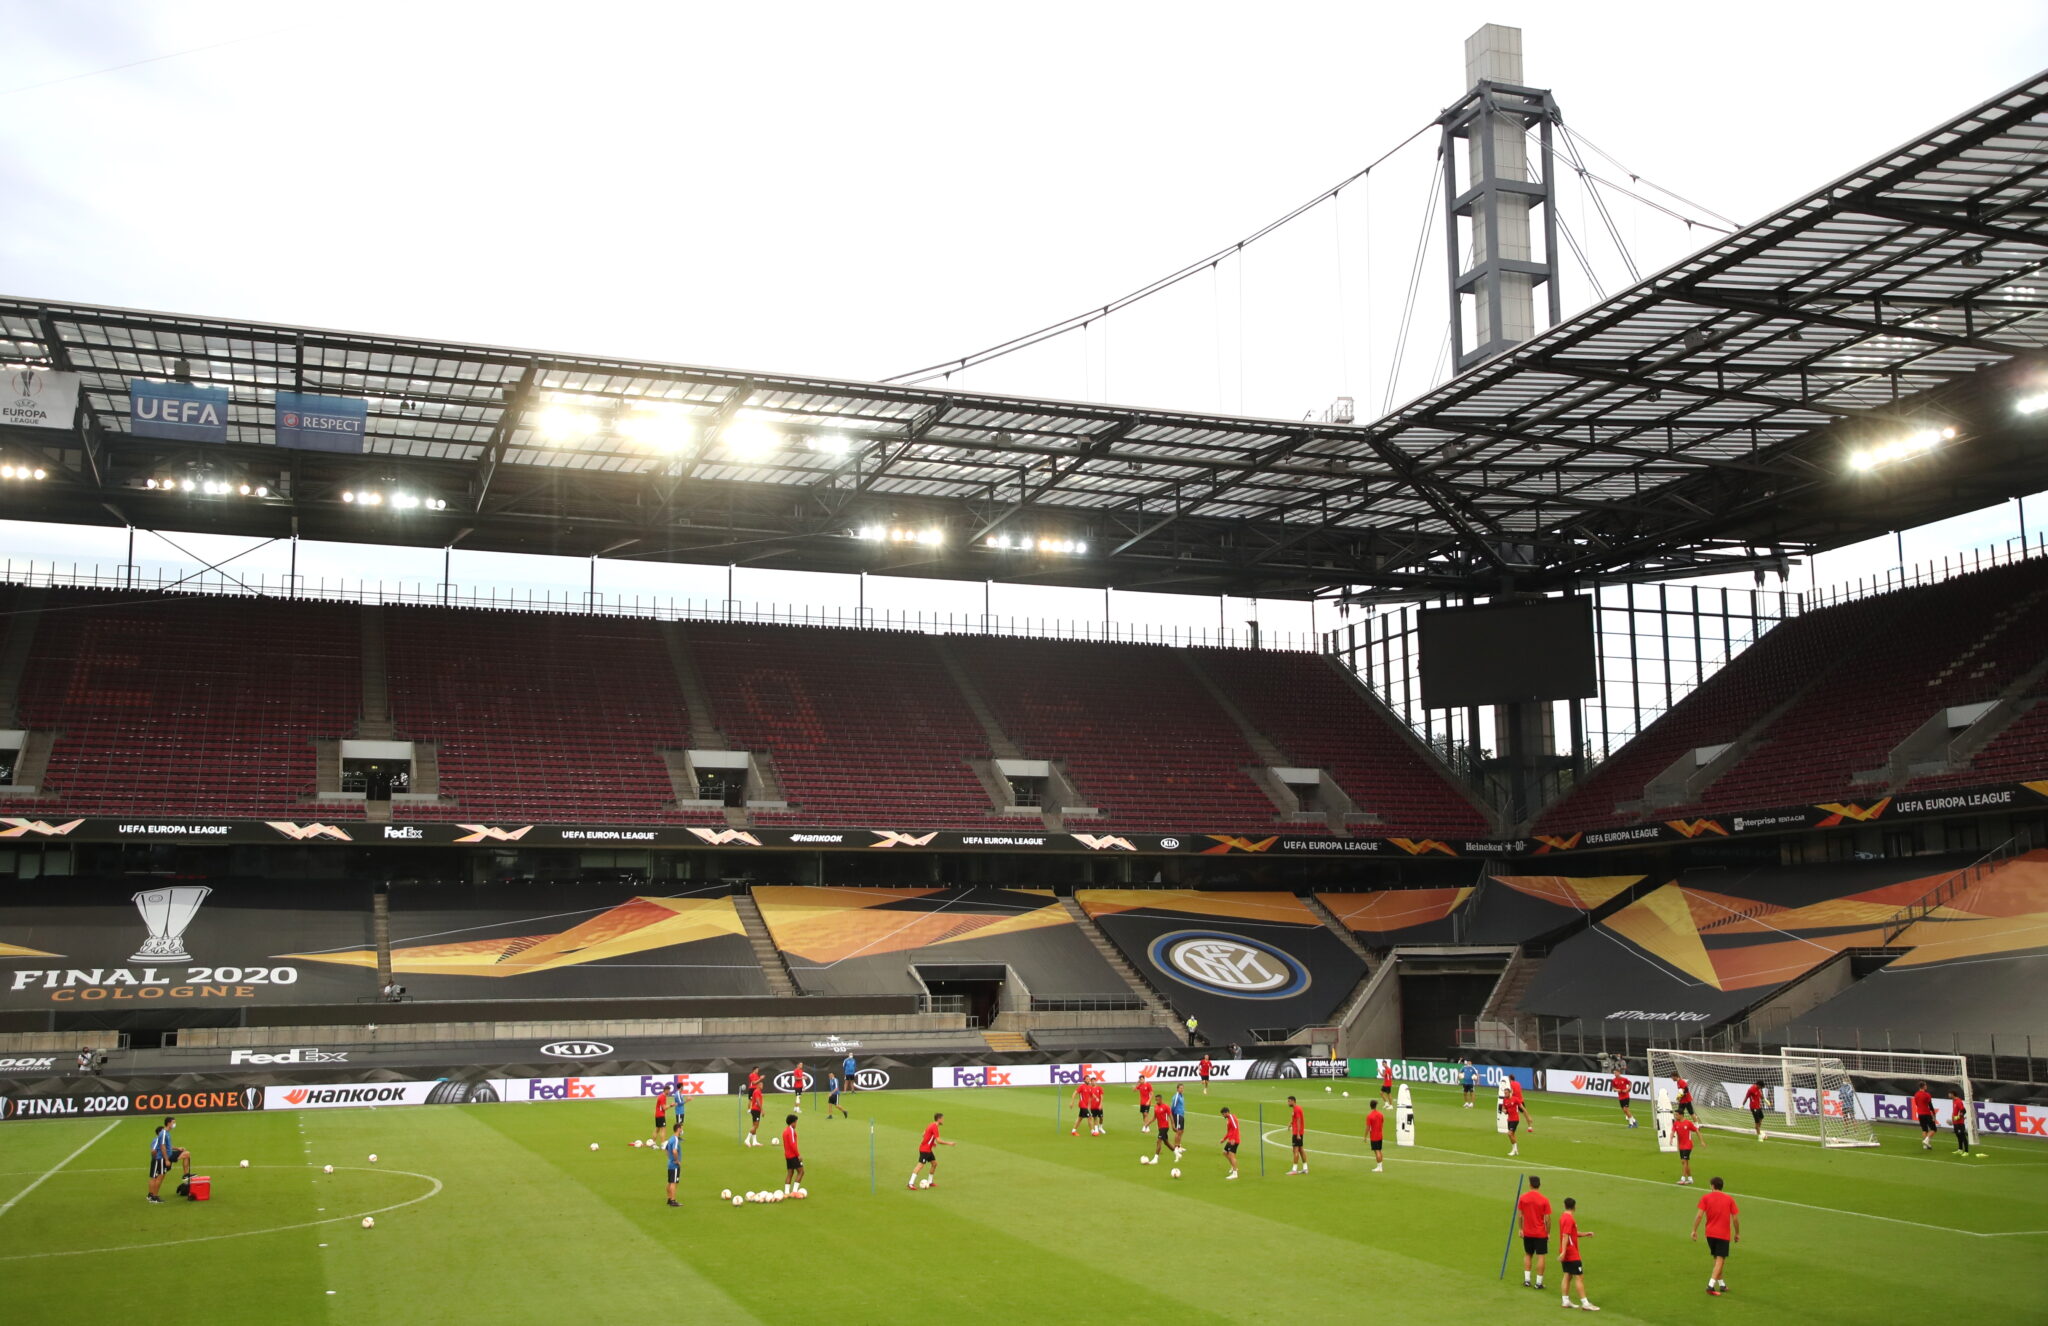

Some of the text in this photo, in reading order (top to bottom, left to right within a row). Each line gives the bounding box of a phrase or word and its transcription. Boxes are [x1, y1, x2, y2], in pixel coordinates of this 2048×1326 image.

[3, 408, 47, 418] EUROPA
[136, 397, 220, 425] UEFA
[303, 416, 361, 431] RESPECT
[1897, 791, 2011, 813] UEFA EUROPA LEAGUE
[119, 825, 228, 834] UEFA EUROPA LEAGUE
[384, 827, 422, 839] FedEx
[562, 831, 585, 839] UEFA
[622, 832, 655, 840] LEAGUE
[1586, 828, 1659, 844] UEFA EUROPA LEAGUE
[963, 837, 1044, 845] UEFA EUROPA LEAGUE
[1284, 841, 1377, 850] UEFA EUROPA LEAGUE
[1466, 842, 1503, 851] Heineken
[10, 967, 298, 991] FINAL 2020
[51, 986, 255, 1001] COLOGNE
[230, 1049, 349, 1065] FedEx
[857, 1074, 883, 1086] KIA
[953, 1066, 1011, 1087] FedEx
[1050, 1064, 1105, 1084] FedEx
[529, 1077, 596, 1099] FedEx
[641, 1075, 705, 1096] FedEx
[16, 1096, 129, 1115] FINAL 2020
[135, 1091, 238, 1110] COLOGNE
